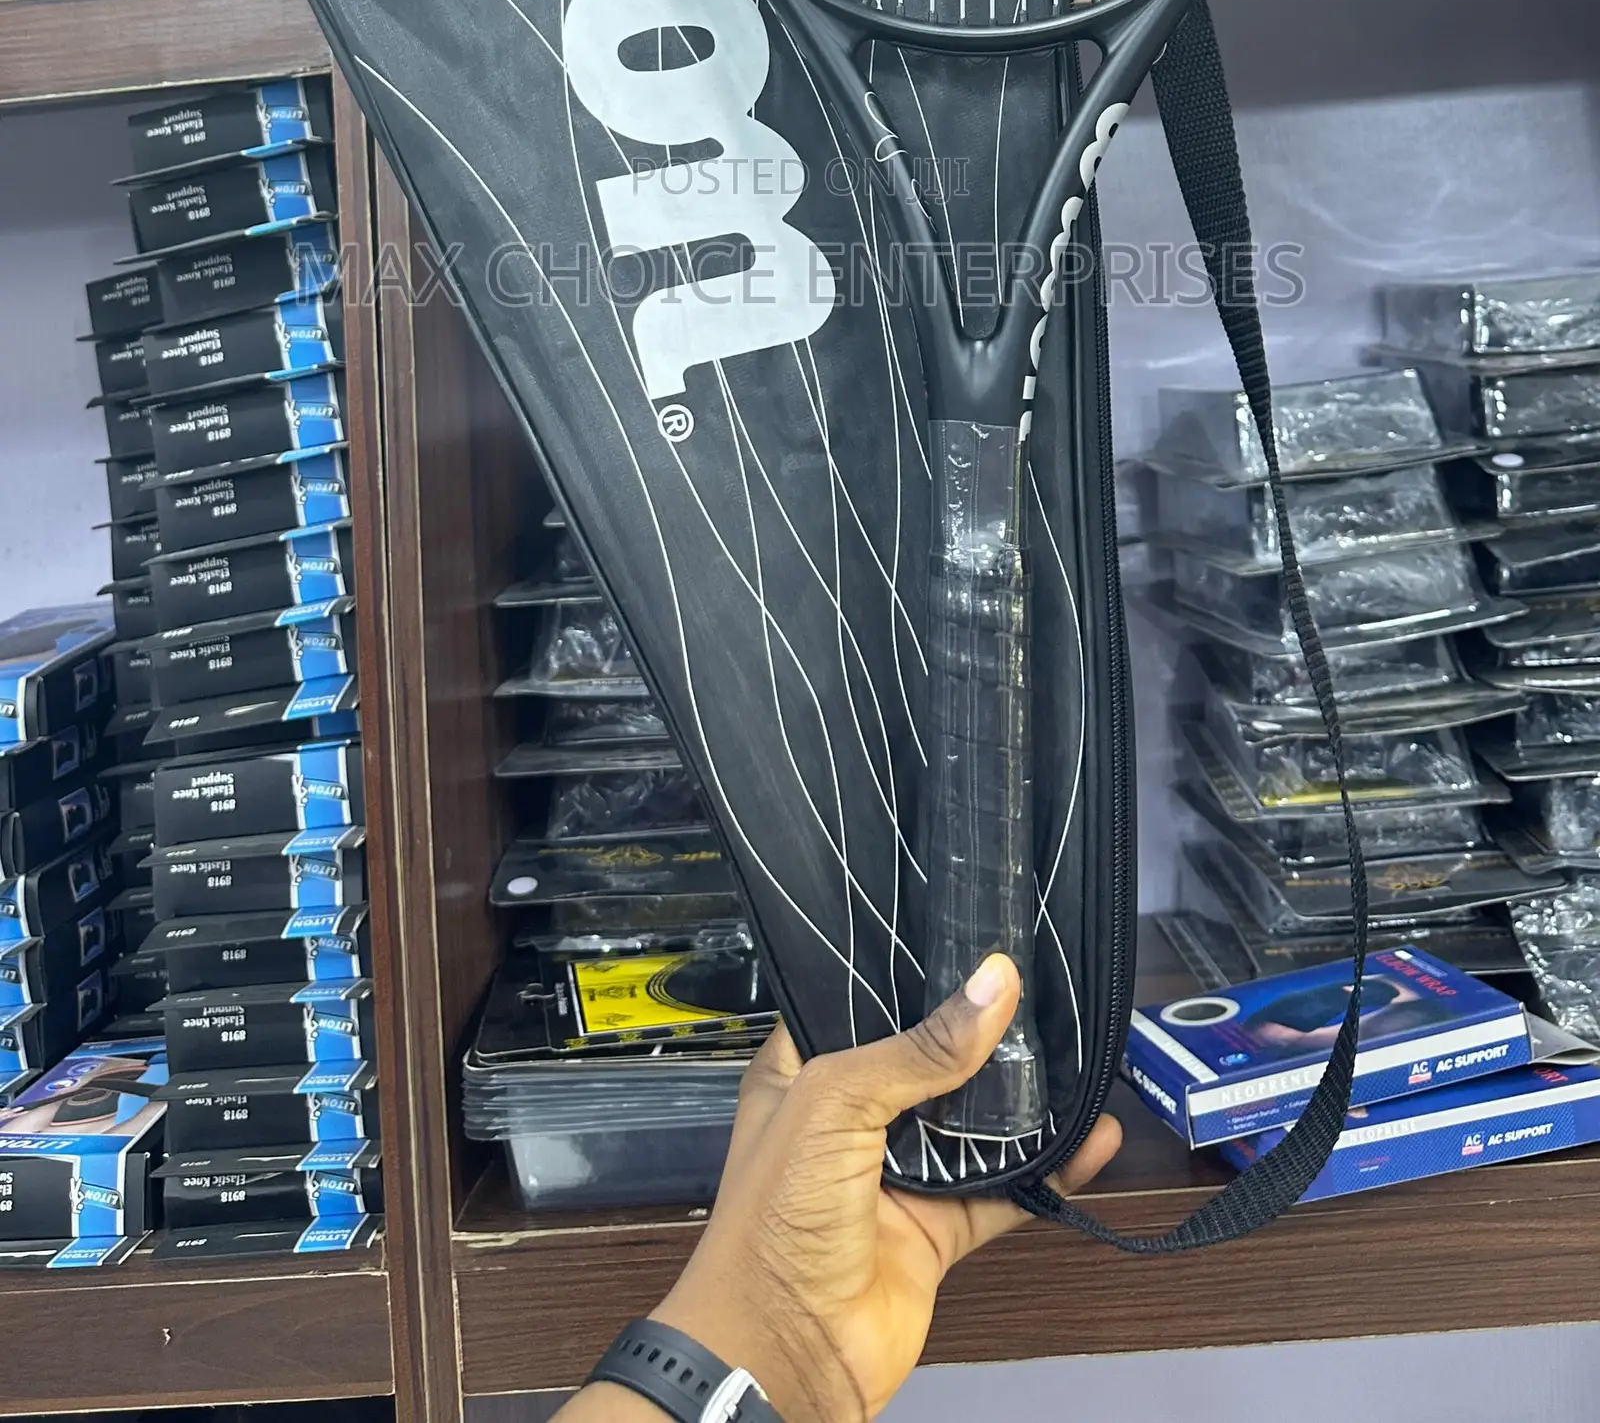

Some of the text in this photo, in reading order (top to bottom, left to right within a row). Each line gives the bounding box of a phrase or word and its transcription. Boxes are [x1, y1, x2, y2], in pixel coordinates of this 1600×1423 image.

[164, 109, 203, 125] Support
[271, 109, 304, 120] LITON
[147, 119, 204, 138] Elastic Knee
[166, 185, 205, 202] Support
[274, 184, 306, 195] LITON
[151, 195, 208, 214] Elastic Knee
[178, 328, 220, 346] Support
[289, 329, 322, 340] LITON
[161, 344, 189, 359] Knee
[190, 338, 222, 353] Elastic
[199, 351, 224, 366] 8918
[187, 404, 229, 420] Support
[300, 406, 334, 418] LITON
[169, 414, 230, 434] Elastic Knee
[207, 427, 232, 442] 8918
[192, 479, 234, 495] Support
[307, 481, 340, 492] LITON
[174, 489, 235, 508] Elastic Knee
[212, 502, 237, 517] 8918
[187, 557, 230, 573] Support
[301, 560, 335, 571] LITON
[169, 567, 231, 586] Elastic Knee
[208, 581, 233, 595] 8918
[301, 636, 336, 648] LITON
[169, 642, 231, 661] Elastic Knee
[208, 656, 233, 671] 8918
[191, 772, 234, 787] Support
[172, 784, 235, 800] Elastic Knee
[308, 784, 342, 796] LITON
[210, 799, 236, 812] 8918
[169, 860, 232, 874] Elastic Knee
[303, 861, 337, 875] LITON
[207, 875, 232, 888] 8918
[317, 937, 351, 950] LITON
[221, 948, 247, 961] 8918
[182, 1015, 245, 1029] Elastic Knee
[319, 1018, 353, 1033] LITON
[221, 1029, 246, 1042] 8918
[1435, 1044, 1509, 1073] AC SUPPORT
[1411, 1061, 1429, 1075] AC
[1221, 1070, 1312, 1104] NEOPRENE
[321, 1096, 356, 1111] LITON
[223, 1108, 249, 1121] 8918
[1465, 1133, 1482, 1147] AC
[1487, 1123, 1554, 1147] AC SUPPORT
[183, 1173, 246, 1187] Elastic Knee
[319, 1177, 355, 1192] LITON
[85, 1190, 119, 1206] LITON
[220, 1190, 246, 1203] 8918
[305, 1233, 350, 1243] LITON
